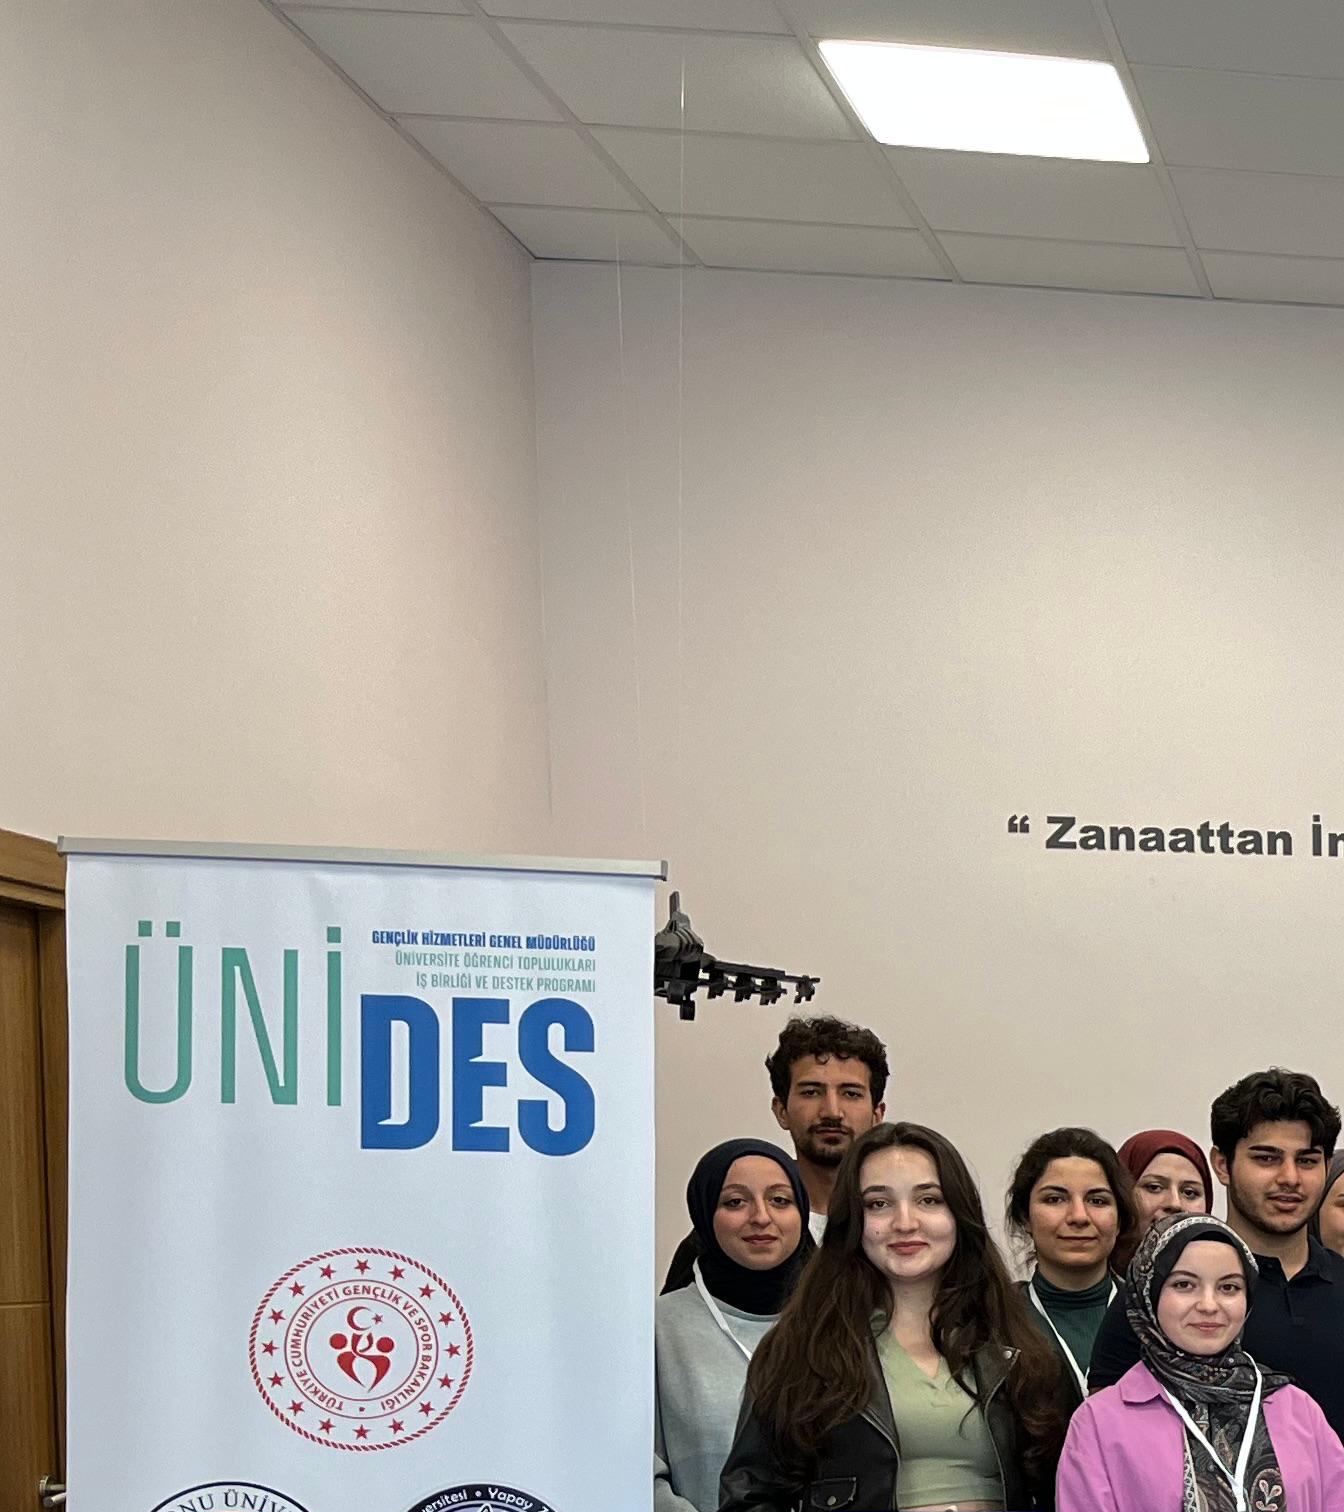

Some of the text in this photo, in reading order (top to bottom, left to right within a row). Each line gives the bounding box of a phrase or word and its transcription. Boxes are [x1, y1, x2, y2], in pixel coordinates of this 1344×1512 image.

[1045, 815, 1293, 856] Zanaattan
[372, 929, 596, 951] GENÇLİK HİZMETLERİ GENEL MÜDÜRLÜĞÜ
[395, 949, 596, 972] ÜNİVERSİTE ÖĞRENCİ TOPLULUKLARI
[416, 972, 596, 993] İŞ BİRLİĞİ VE DESTEK PROGRAMI
[290, 1284, 433, 1411] TÜRKİYE CUMHURİYETİ GENÇLİK VE SPOR BAKANLIĞI
[487, 1487, 533, 1511] Yapay
